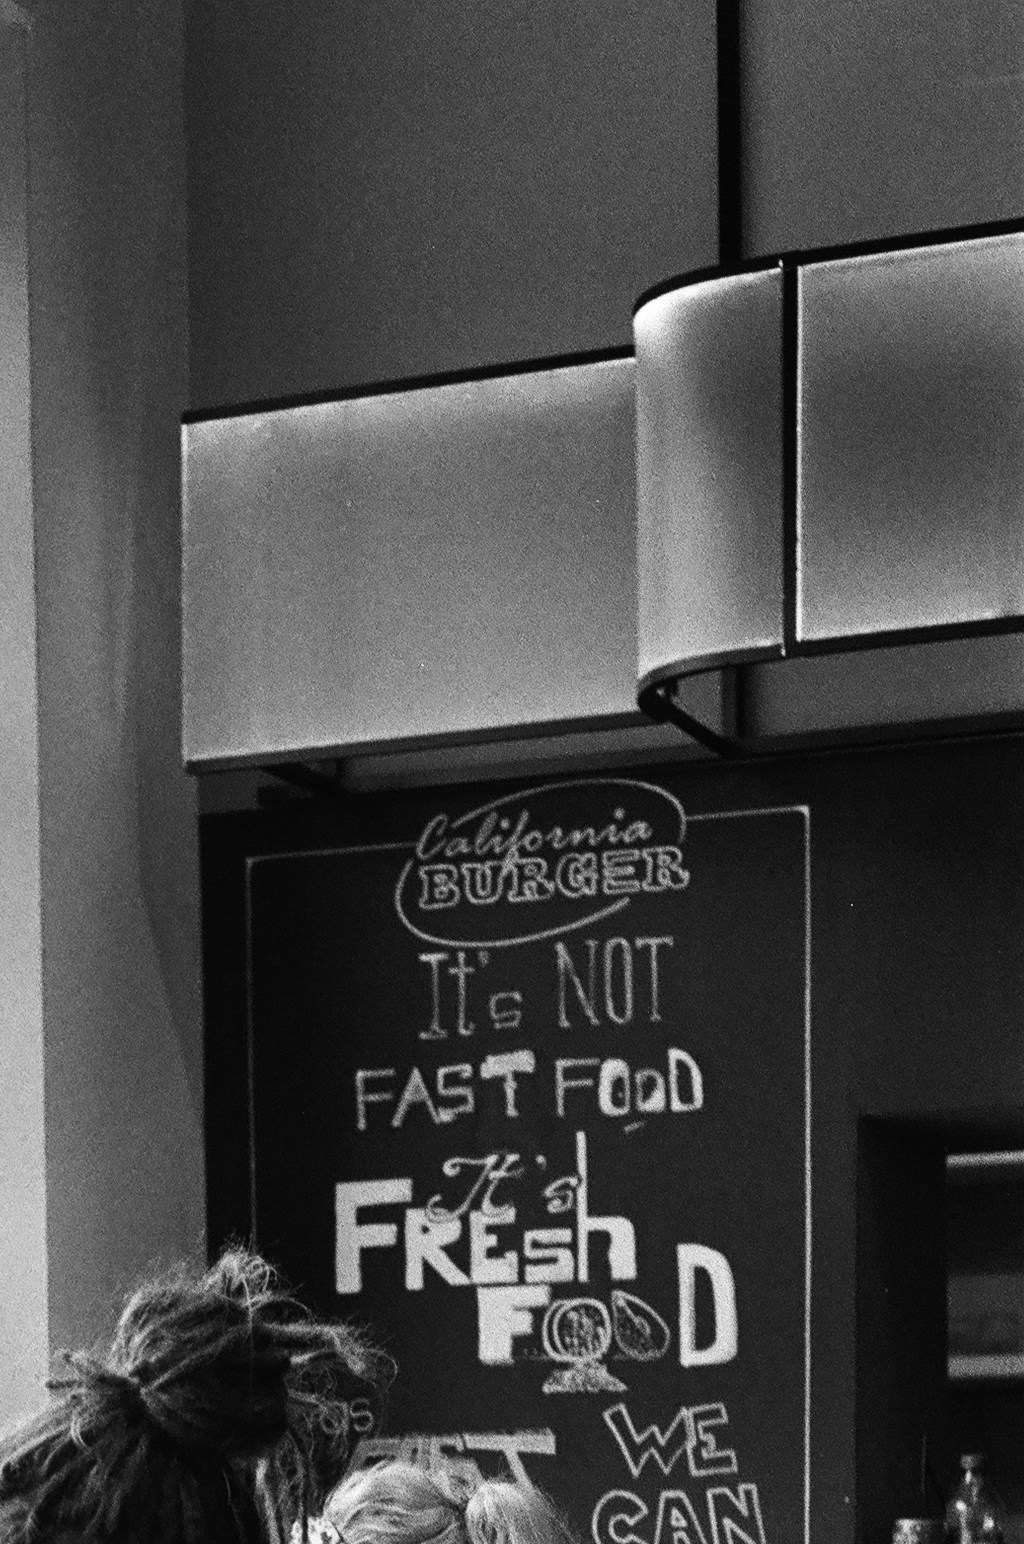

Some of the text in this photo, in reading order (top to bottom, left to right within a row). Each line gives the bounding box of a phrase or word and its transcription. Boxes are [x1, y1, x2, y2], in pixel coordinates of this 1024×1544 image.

[416, 808, 653, 874] California
[419, 846, 690, 910] BURGER
[419, 937, 674, 1040] It's NOT
[355, 1047, 704, 1131] FAST FOOD
[426, 1153, 584, 1223] It's
[477, 1243, 738, 1370] FOOD
[603, 1402, 738, 1478] WE
